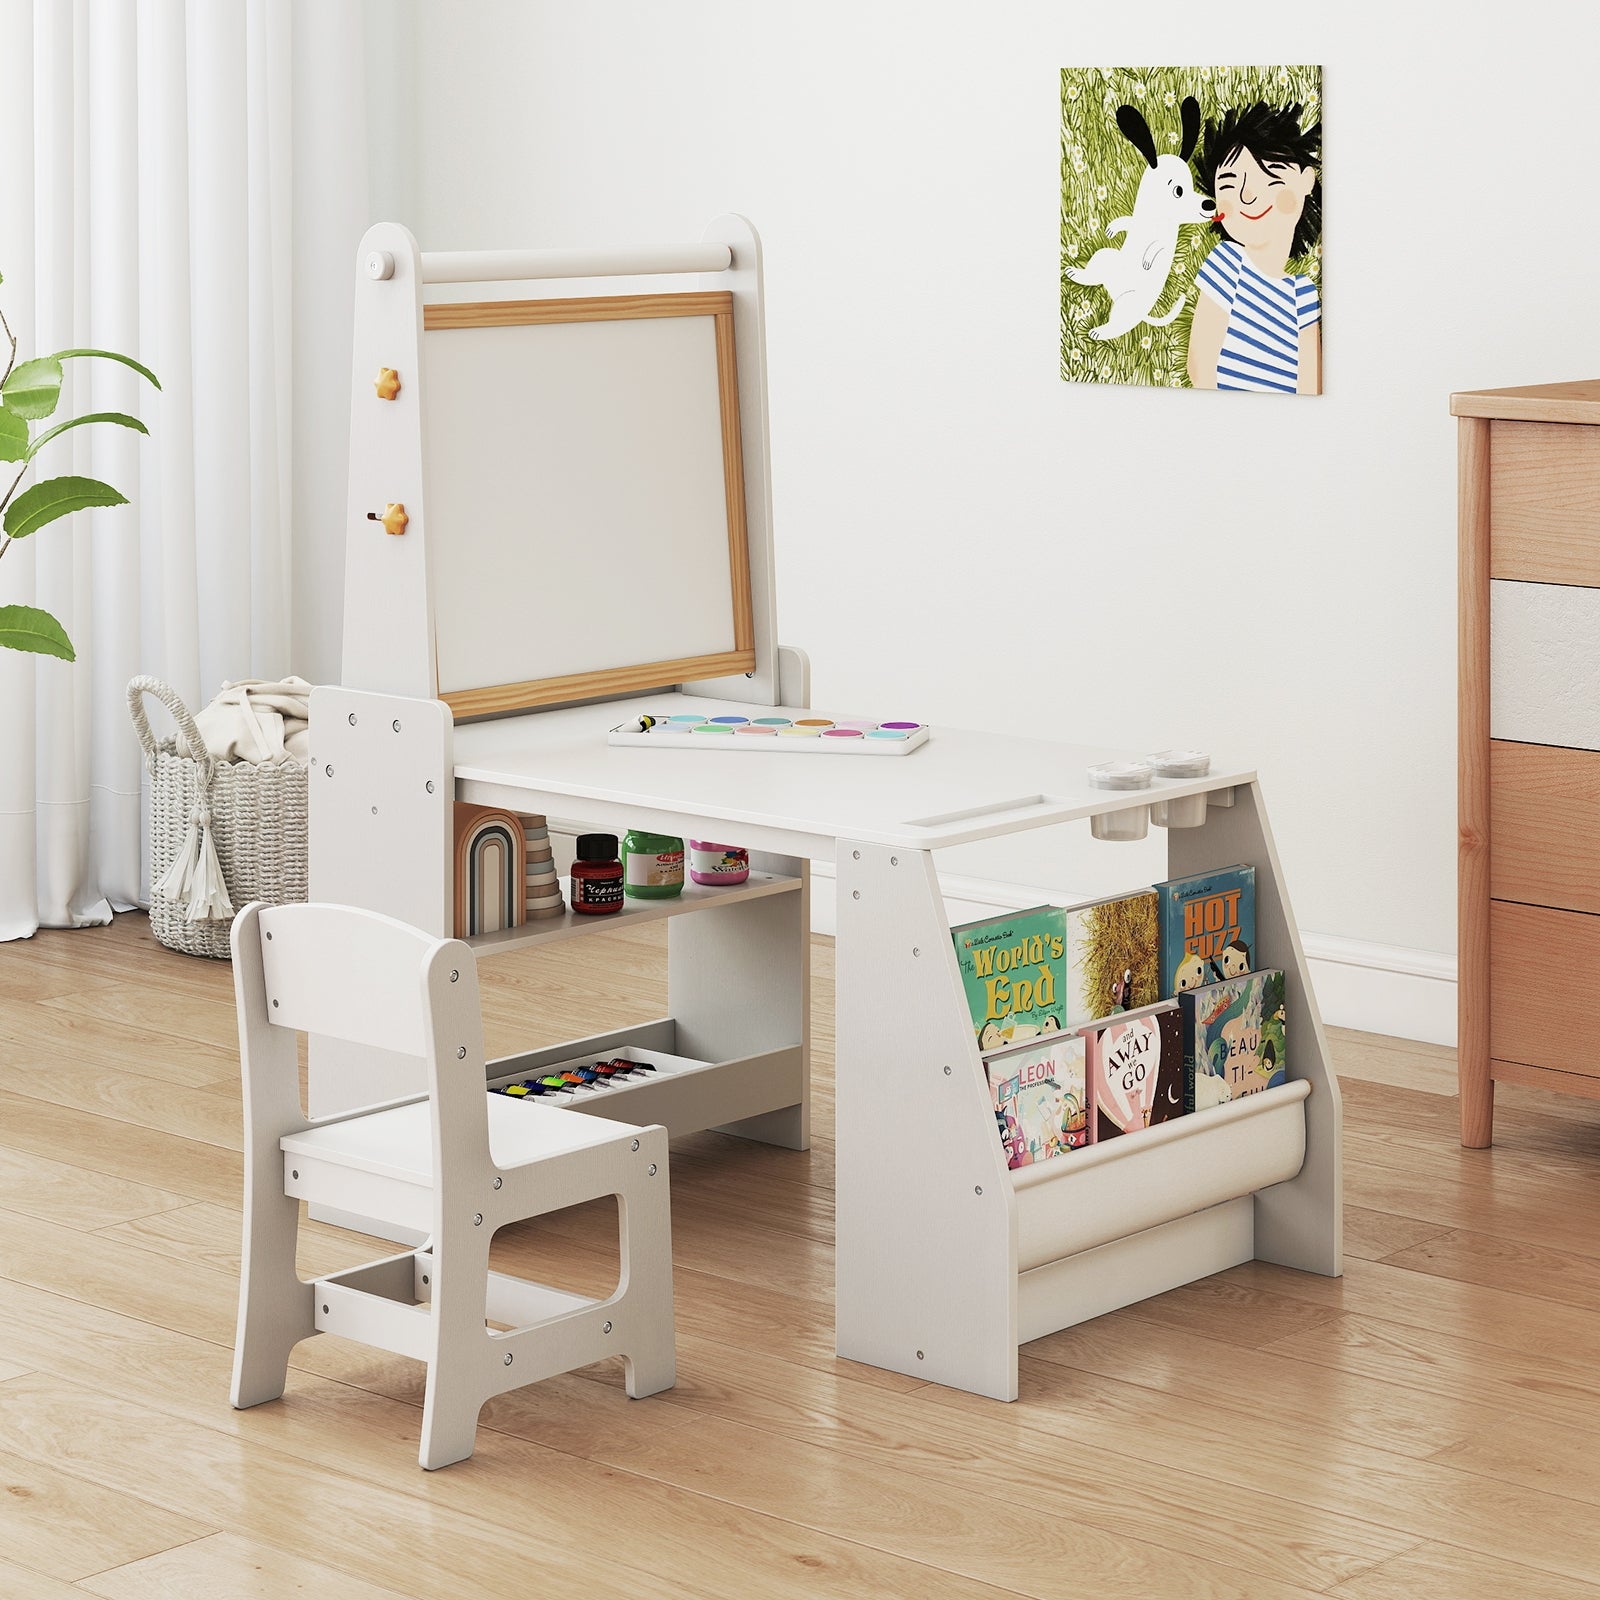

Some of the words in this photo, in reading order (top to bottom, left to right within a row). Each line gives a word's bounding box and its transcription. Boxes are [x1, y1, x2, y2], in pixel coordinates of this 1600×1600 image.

[1184, 893, 1242, 939] HOT
[960, 961, 975, 974] The
[972, 933, 1064, 979] World's
[985, 964, 1056, 1022] End
[1122, 1028, 1135, 1043] and
[1220, 1033, 1266, 1061] BEAU-
[1108, 1032, 1152, 1078] AWAY
[1127, 1059, 1137, 1070] we
[1020, 1060, 1055, 1085] LEON
[1122, 1063, 1146, 1091] GO
[1184, 1055, 1195, 1090] world
[1232, 1064, 1254, 1083] TI-
